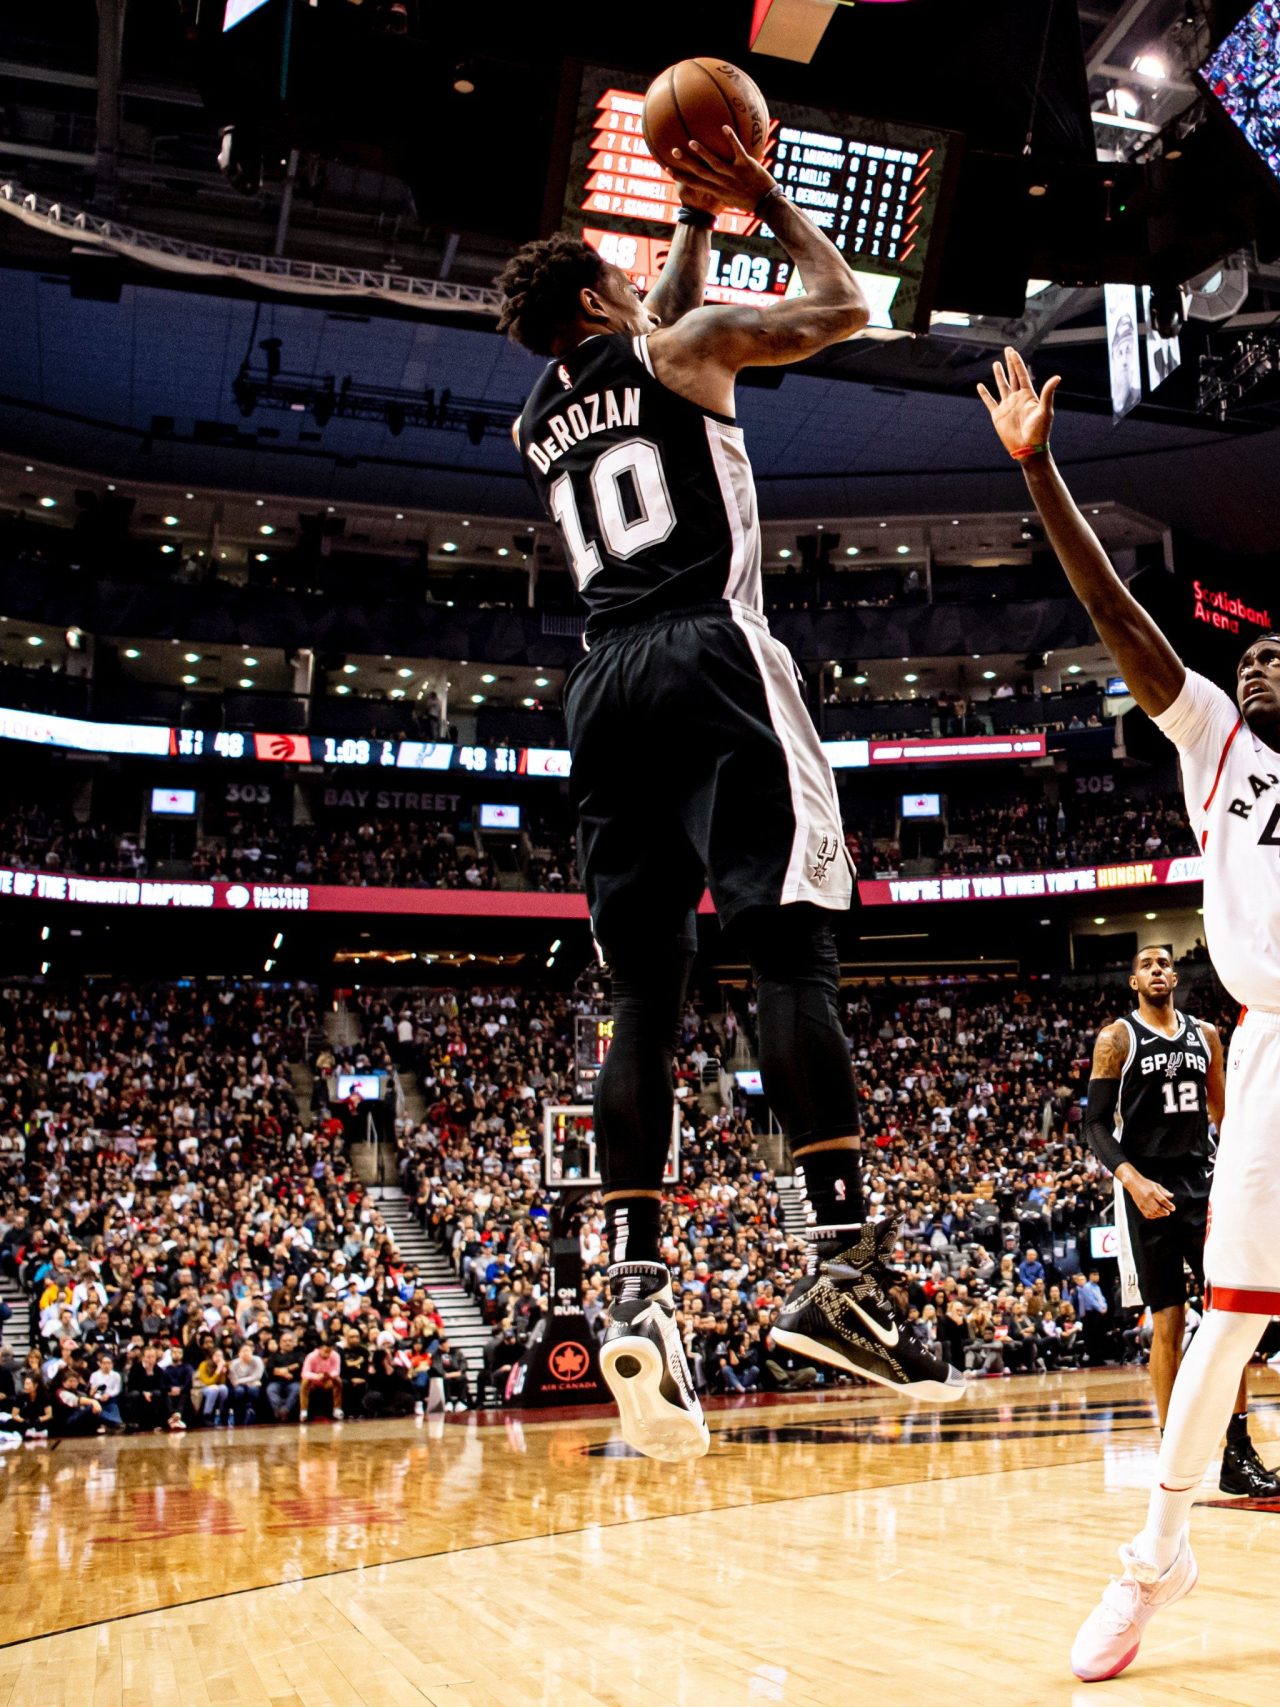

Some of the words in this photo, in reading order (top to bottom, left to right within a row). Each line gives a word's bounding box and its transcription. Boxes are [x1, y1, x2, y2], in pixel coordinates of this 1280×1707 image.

[777, 143, 787, 159] 5
[868, 160, 878, 176] 5
[885, 163, 896, 179] 4
[799, 167, 831, 187] MILLS
[846, 176, 857, 192] 4
[864, 179, 873, 195] 1
[899, 185, 908, 201] 1
[861, 199, 871, 214] 4
[878, 202, 888, 217] 2
[895, 205, 904, 220] 1
[841, 215, 850, 230] 7
[857, 218, 867, 234] 2
[874, 221, 885, 237] 2
[836, 234, 846, 250] 4
[854, 237, 864, 252] 7
[871, 240, 880, 255] 1
[888, 243, 897, 258] 1
[706, 250, 771, 292] 1:03
[776, 263, 789, 283] 2
[528, 388, 641, 475] DeROZAN
[550, 437, 677, 592] 10
[1193, 580, 1272, 628] Scotiabank
[1194, 601, 1239, 634] Arena
[214, 732, 244, 757] 48
[226, 784, 271, 803] 303
[1075, 774, 1115, 794] 305
[324, 788, 369, 808] BAY
[377, 790, 461, 813] STREET
[37, 874, 67, 899] THE
[68, 878, 140, 905] TORONTO
[140, 883, 214, 907] RAPTORS
[972, 877, 1002, 898] YOU
[1141, 1051, 1207, 1079] SPURS
[1161, 1081, 1200, 1114] 12
[558, 1287, 577, 1299] ON
[541, 1383, 557, 1391] AIR
[559, 1380, 597, 1391] CANADA
